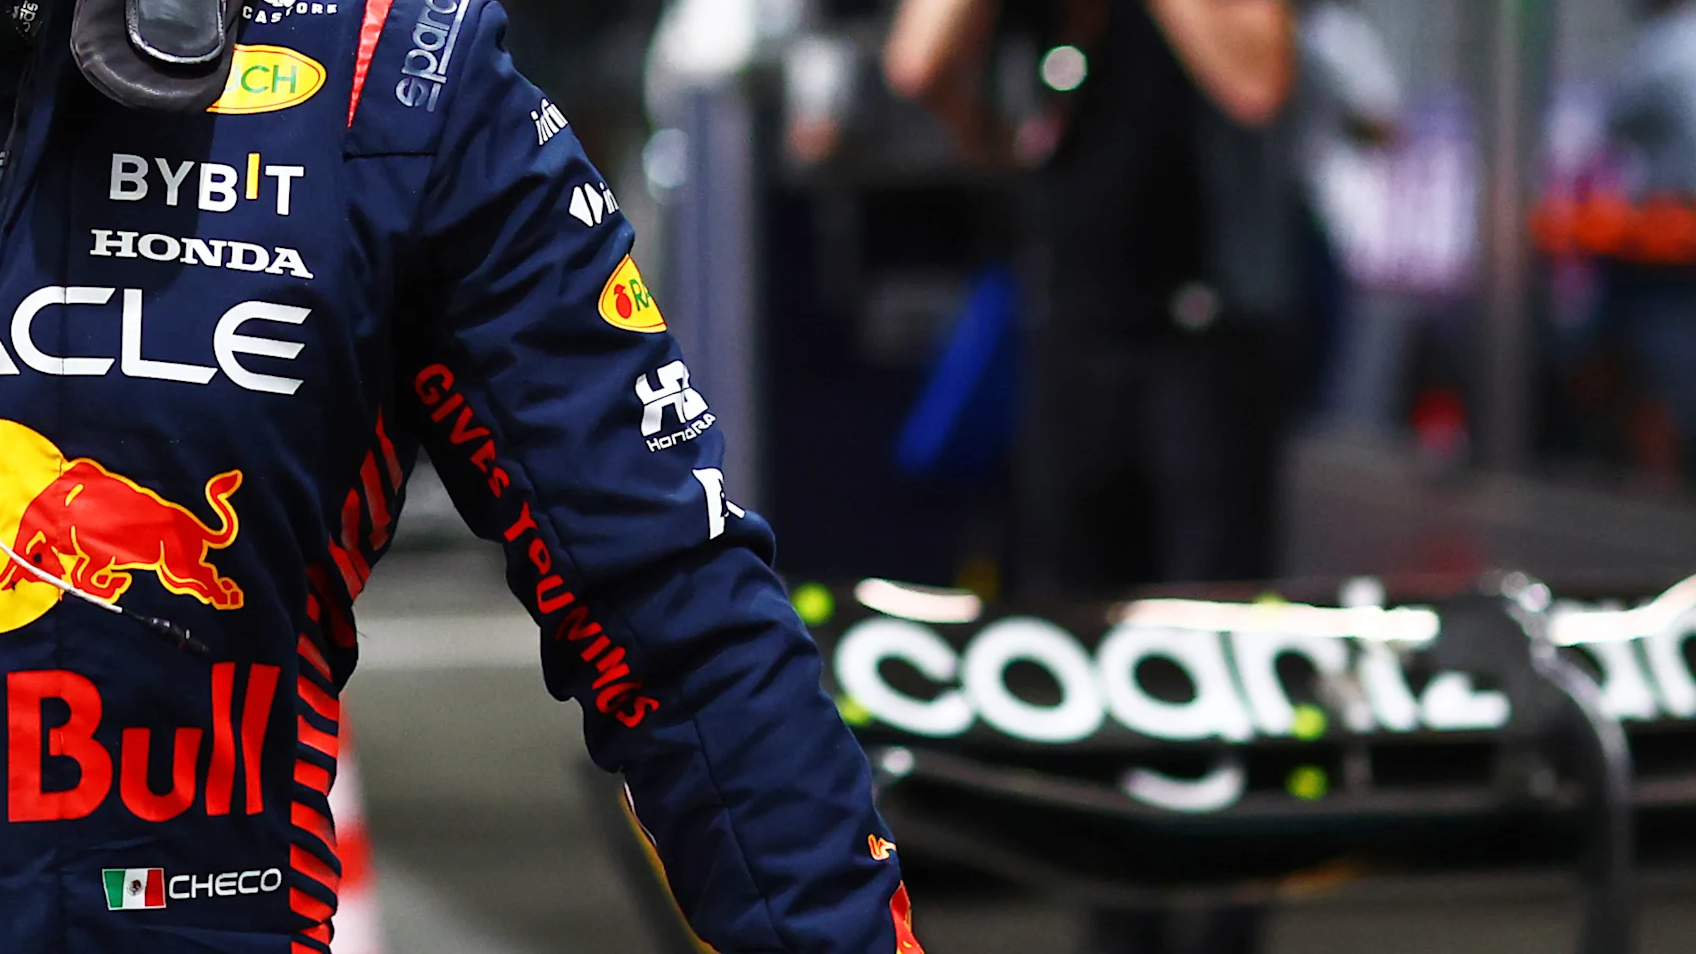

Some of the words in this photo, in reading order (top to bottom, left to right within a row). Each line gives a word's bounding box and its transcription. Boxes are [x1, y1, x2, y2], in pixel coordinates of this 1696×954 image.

[109, 152, 305, 216] BYBIT
[90, 228, 314, 280] HONDA
[414, 363, 511, 499] GIVES
[504, 501, 576, 614] YOU
[7, 661, 282, 824] Bull
[168, 867, 283, 900] CHECO
